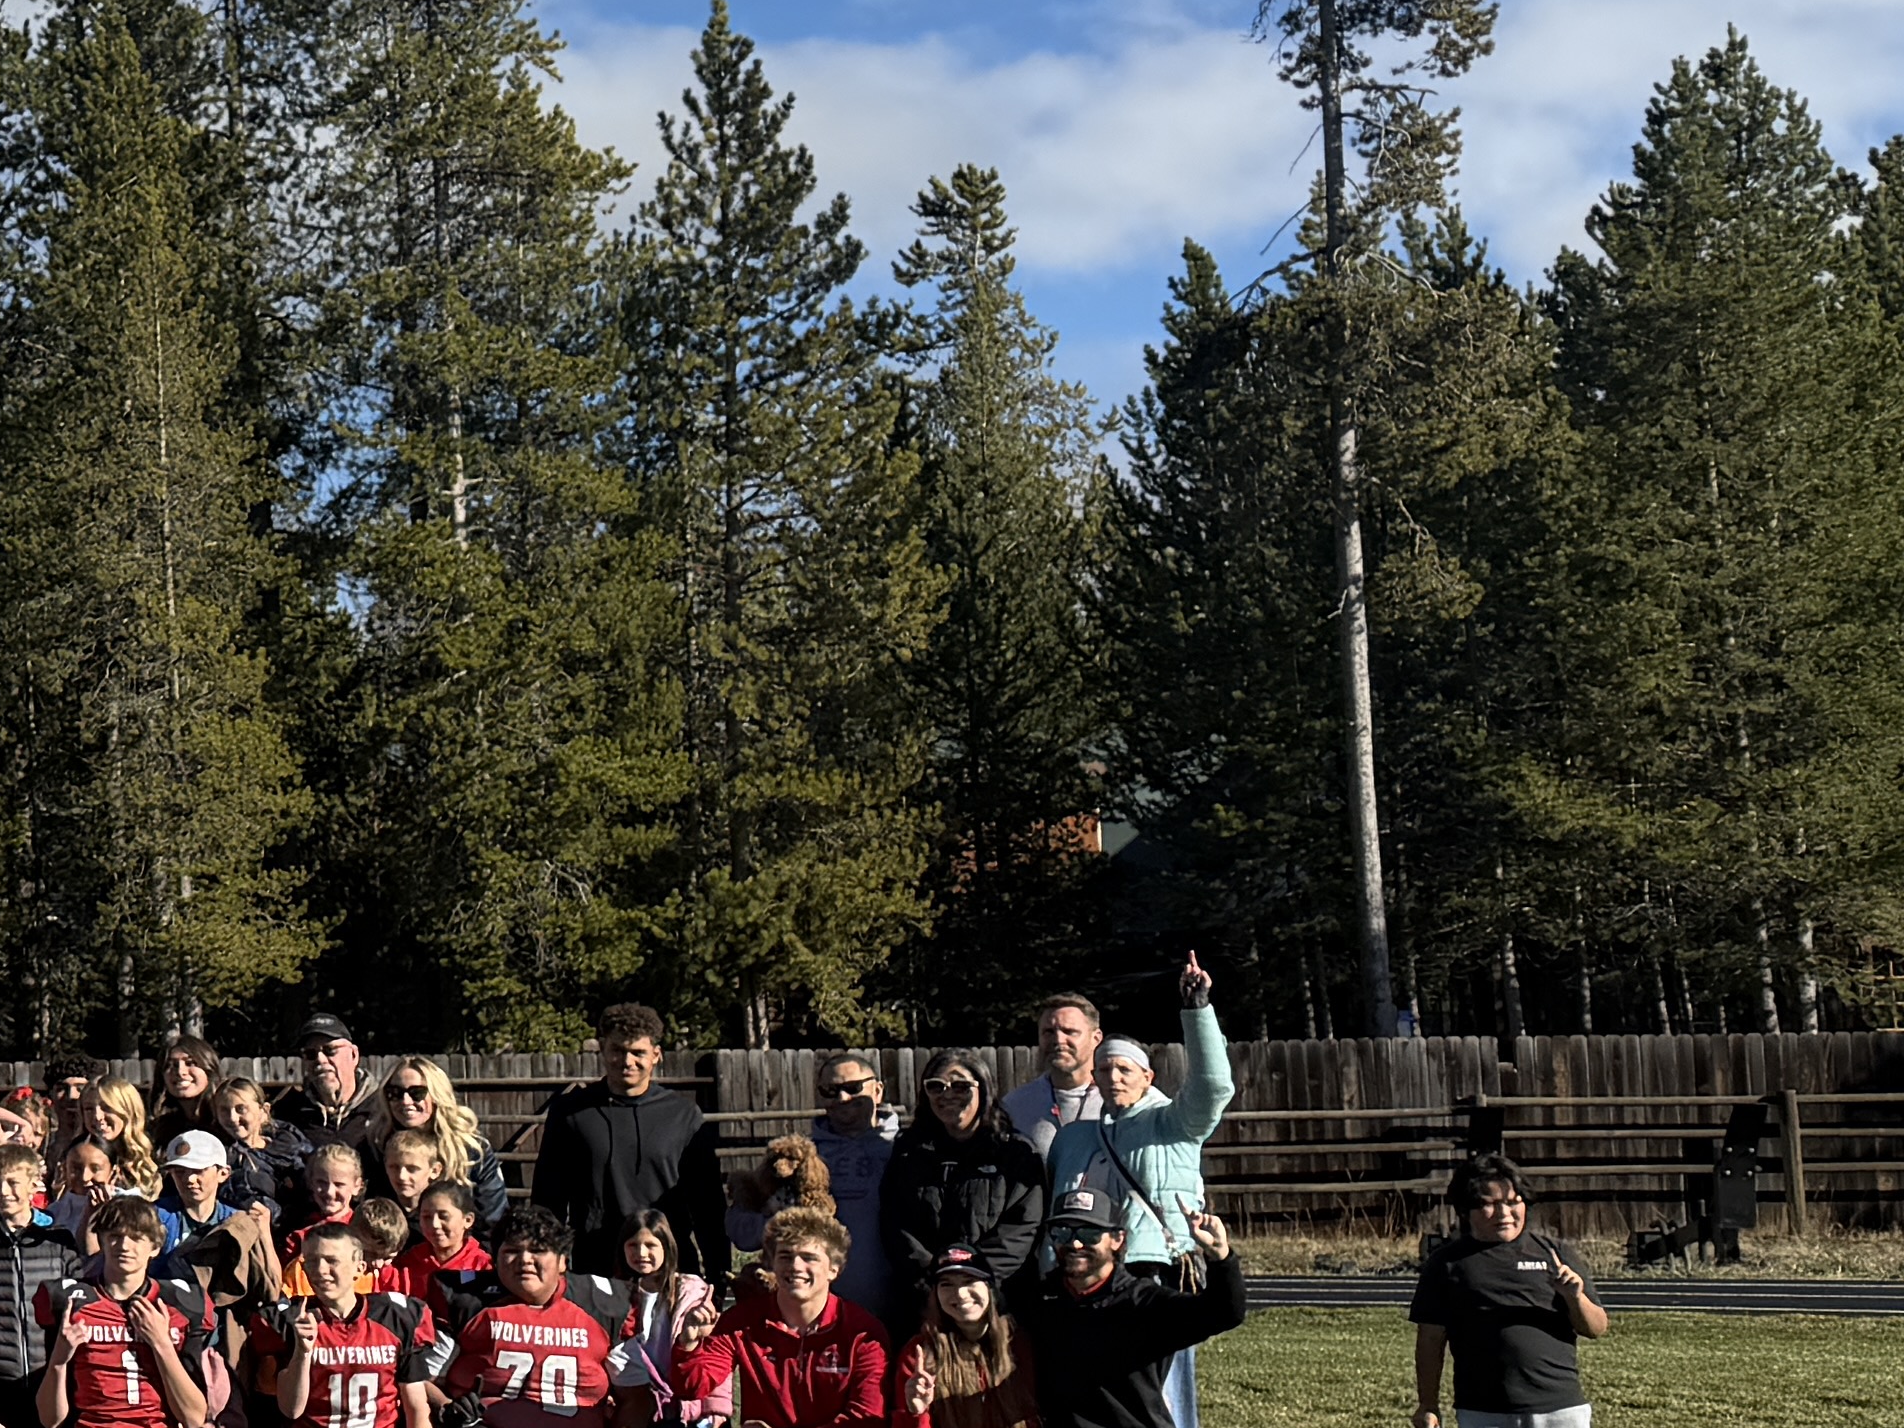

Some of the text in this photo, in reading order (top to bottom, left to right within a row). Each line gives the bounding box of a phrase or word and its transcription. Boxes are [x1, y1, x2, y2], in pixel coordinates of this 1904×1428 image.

[490, 1321, 589, 1349] WOLVERINES
[121, 1350, 140, 1405] 1
[496, 1350, 578, 1417] 70
